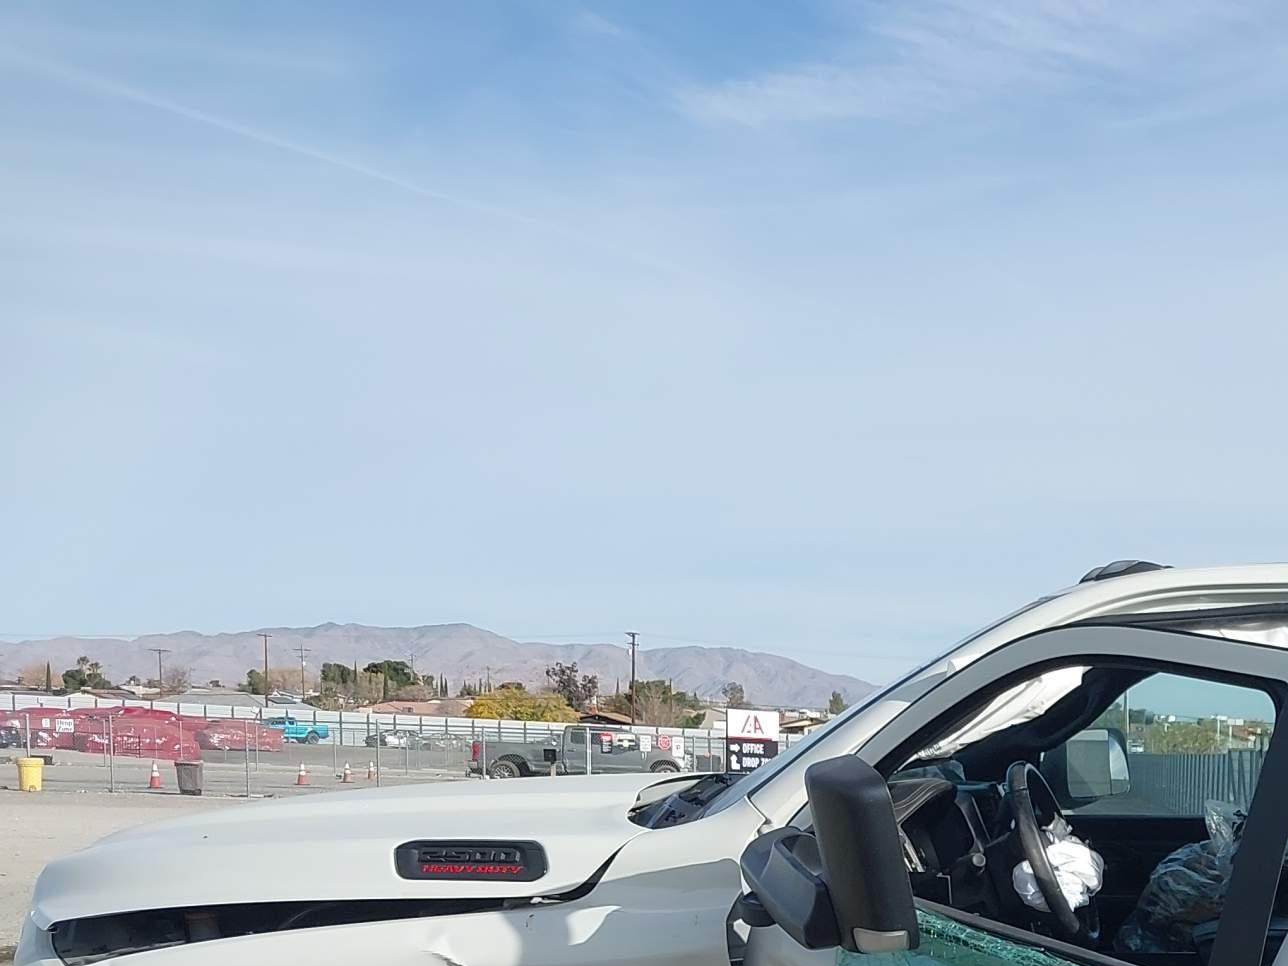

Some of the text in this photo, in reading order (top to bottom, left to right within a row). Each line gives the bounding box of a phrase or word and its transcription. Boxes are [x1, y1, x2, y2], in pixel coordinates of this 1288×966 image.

[742, 743, 765, 754] OFFICE
[742, 757, 760, 768] DROP
[418, 848, 520, 863] 2500
